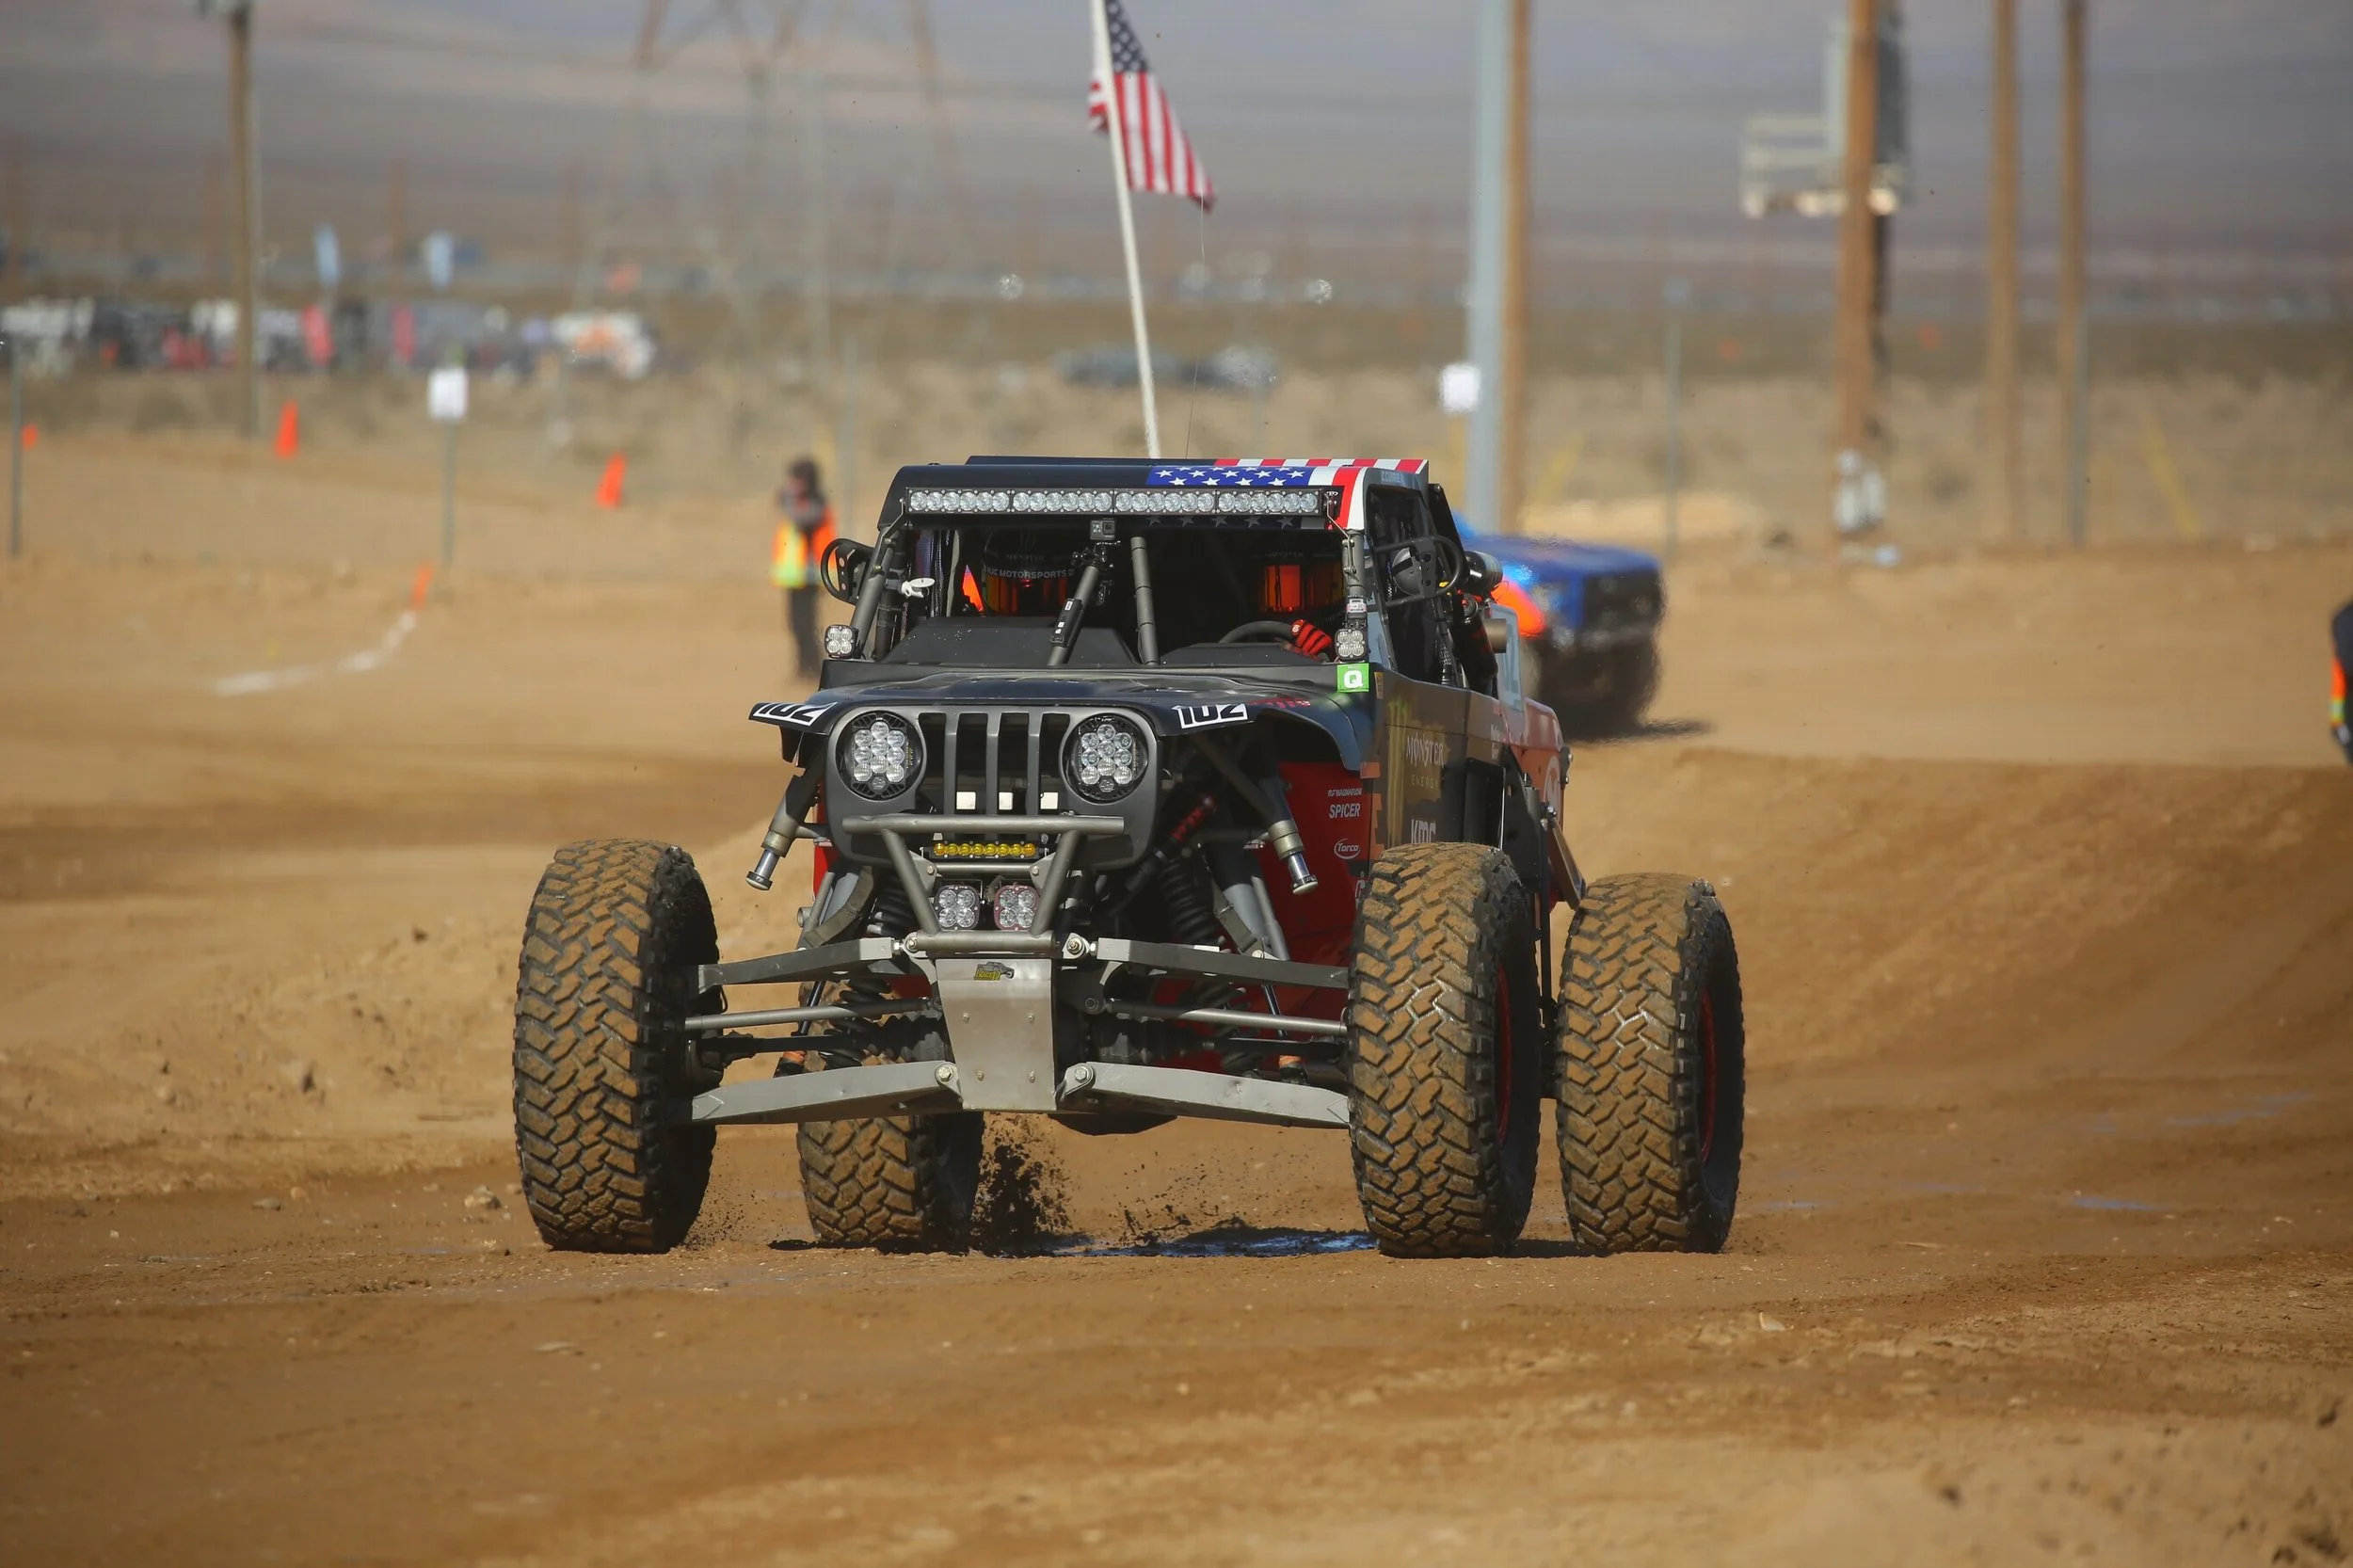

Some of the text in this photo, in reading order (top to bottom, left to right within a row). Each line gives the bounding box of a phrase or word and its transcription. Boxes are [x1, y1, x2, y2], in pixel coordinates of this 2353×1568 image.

[999, 568, 1067, 580] MOTORSPORTS
[1344, 670, 1363, 689] Q
[1406, 731, 1445, 769] MONSTER
[1411, 775, 1439, 791] ENERGY
[1328, 803, 1361, 819] SPICER
[1337, 842, 1359, 853] Torco
